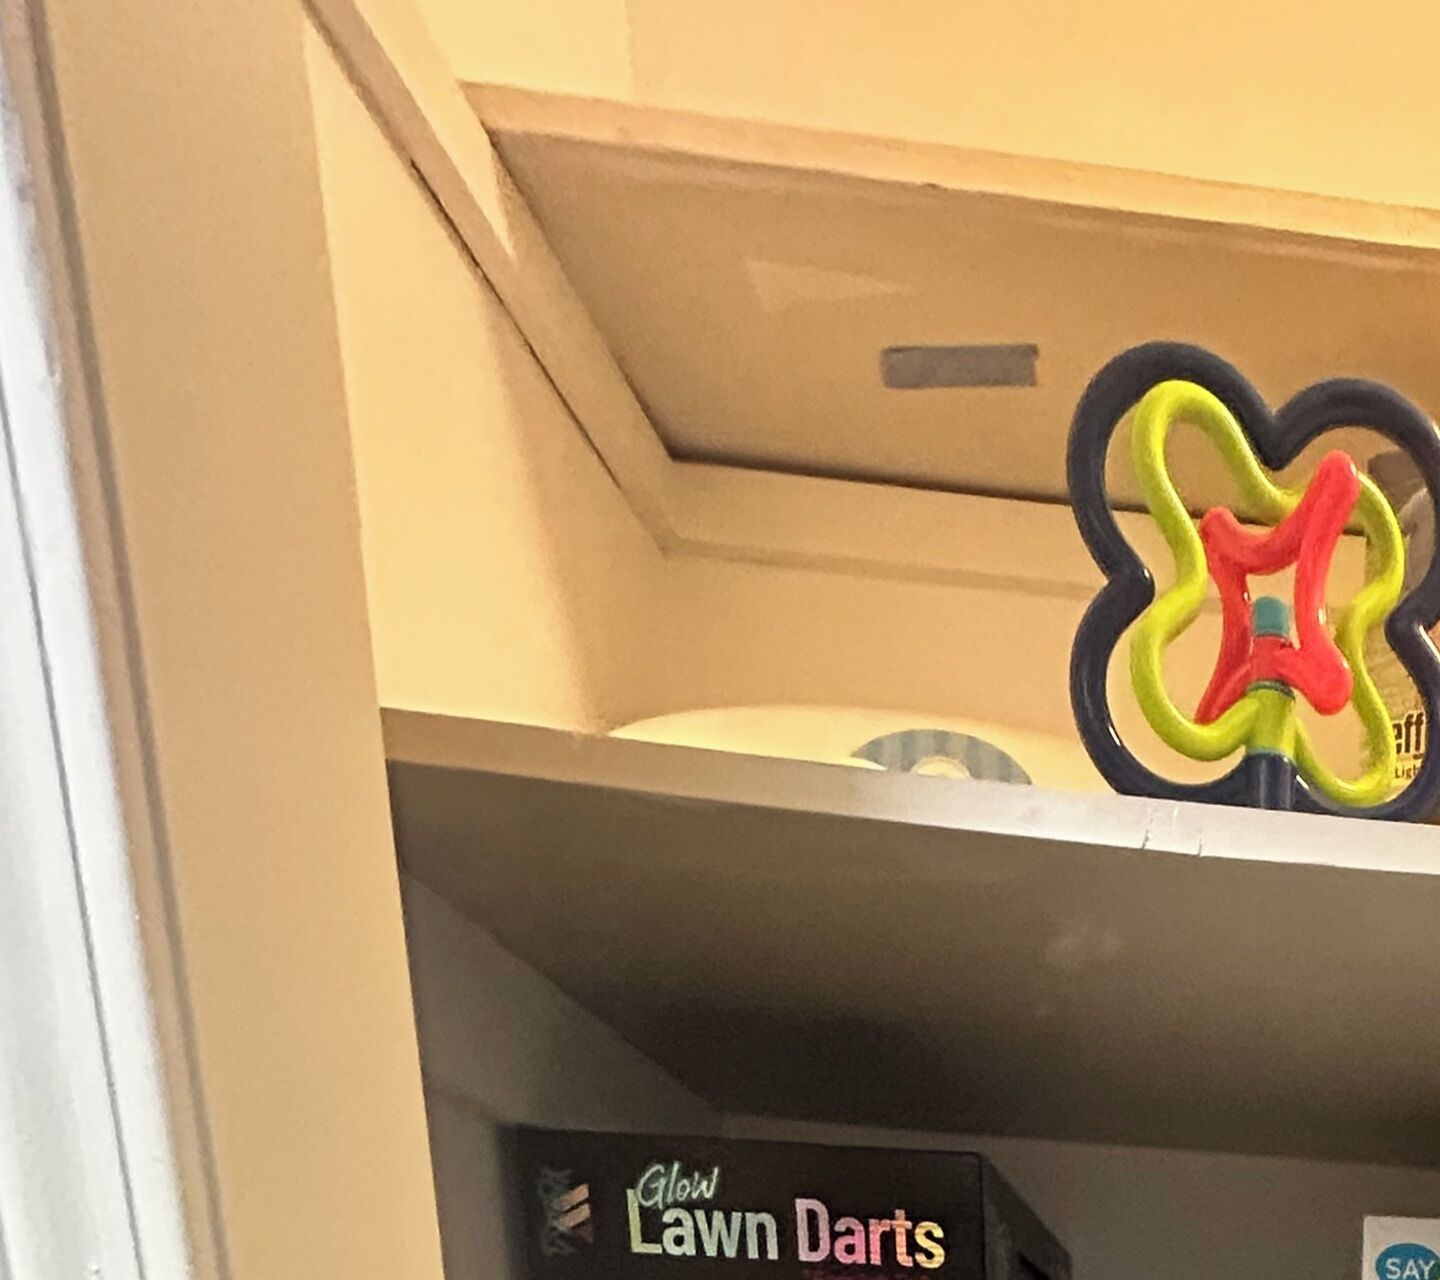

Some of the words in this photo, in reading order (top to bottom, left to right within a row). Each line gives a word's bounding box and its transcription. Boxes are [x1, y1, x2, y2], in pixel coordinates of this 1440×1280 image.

[635, 1160, 719, 1209] Glow
[626, 1187, 779, 1261] Lawn
[794, 1197, 947, 1269] Darts
[1385, 1257, 1436, 1280] SAY
